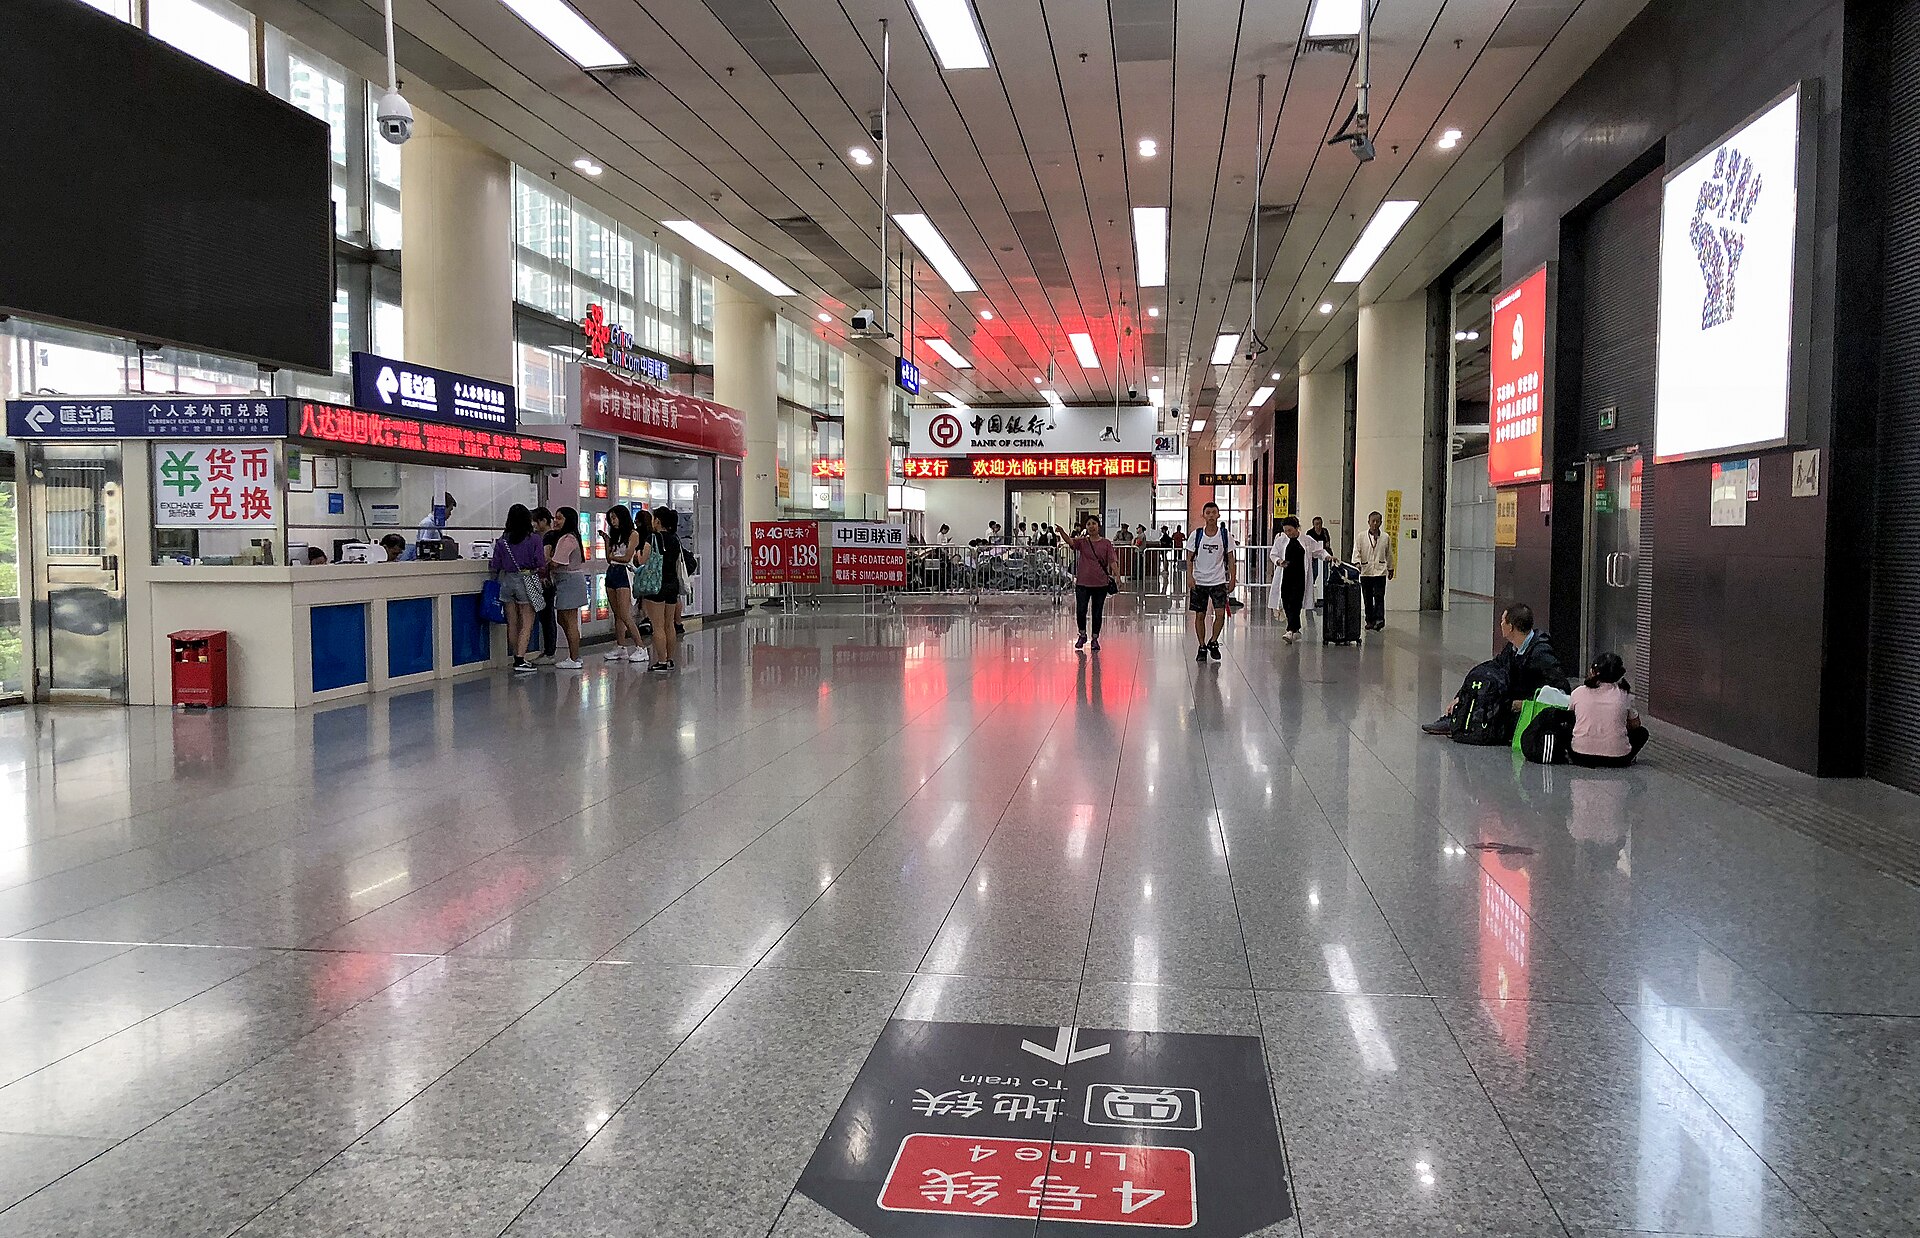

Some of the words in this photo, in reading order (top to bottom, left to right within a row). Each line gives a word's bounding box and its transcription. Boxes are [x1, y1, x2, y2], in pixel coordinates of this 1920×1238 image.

[148, 403, 270, 418] 个人本外币兑换
[299, 404, 385, 446] 八达通回收
[971, 439, 997, 447] BANK
[998, 439, 1011, 447] OF
[1012, 439, 1045, 447] CHINA
[1155, 437, 1171, 451] 24
[205, 447, 269, 482] 货币
[972, 459, 1151, 476] 欢迎光临中国银行福田口
[207, 486, 272, 520] 兑换
[168, 509, 196, 518] 货币兑换
[837, 527, 902, 544] 中国联通
[868, 555, 885, 565] DATE
[885, 555, 904, 565] CARD
[959, 1074, 1021, 1089] train
[1032, 1078, 1069, 1091] To
[911, 1088, 1066, 1123] 地铁
[968, 1144, 998, 1163] 4
[1014, 1146, 1127, 1171] Line
[918, 1167, 1166, 1214] 4号线
